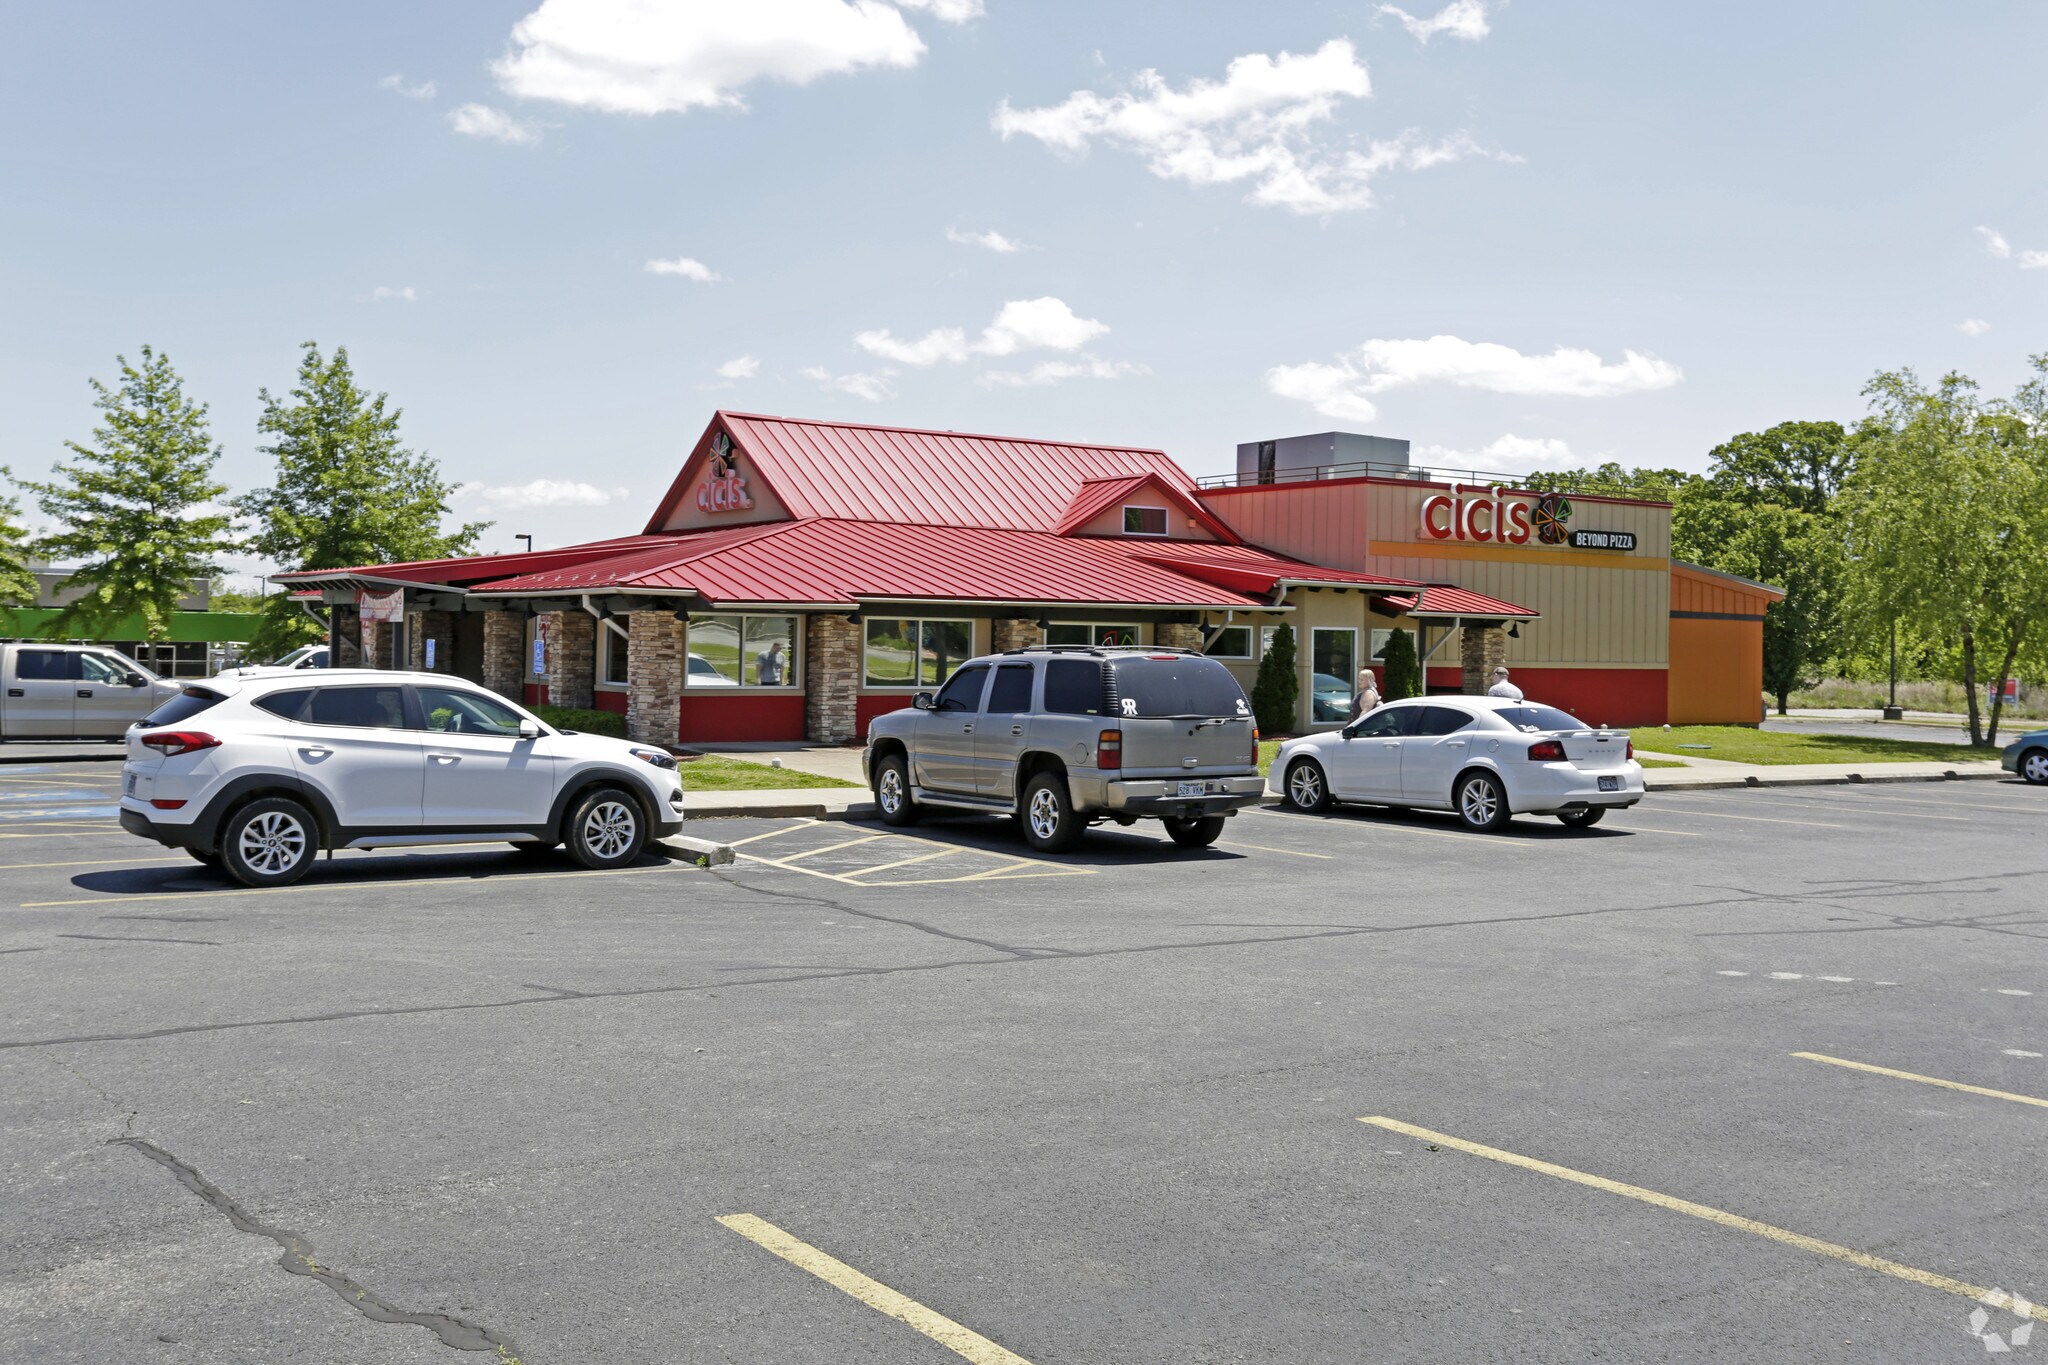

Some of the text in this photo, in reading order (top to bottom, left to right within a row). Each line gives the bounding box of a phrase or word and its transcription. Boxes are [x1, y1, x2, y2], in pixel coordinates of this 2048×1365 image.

[1421, 483, 1531, 544] cicis
[1576, 532, 1633, 549] BEYOND PIZZA
